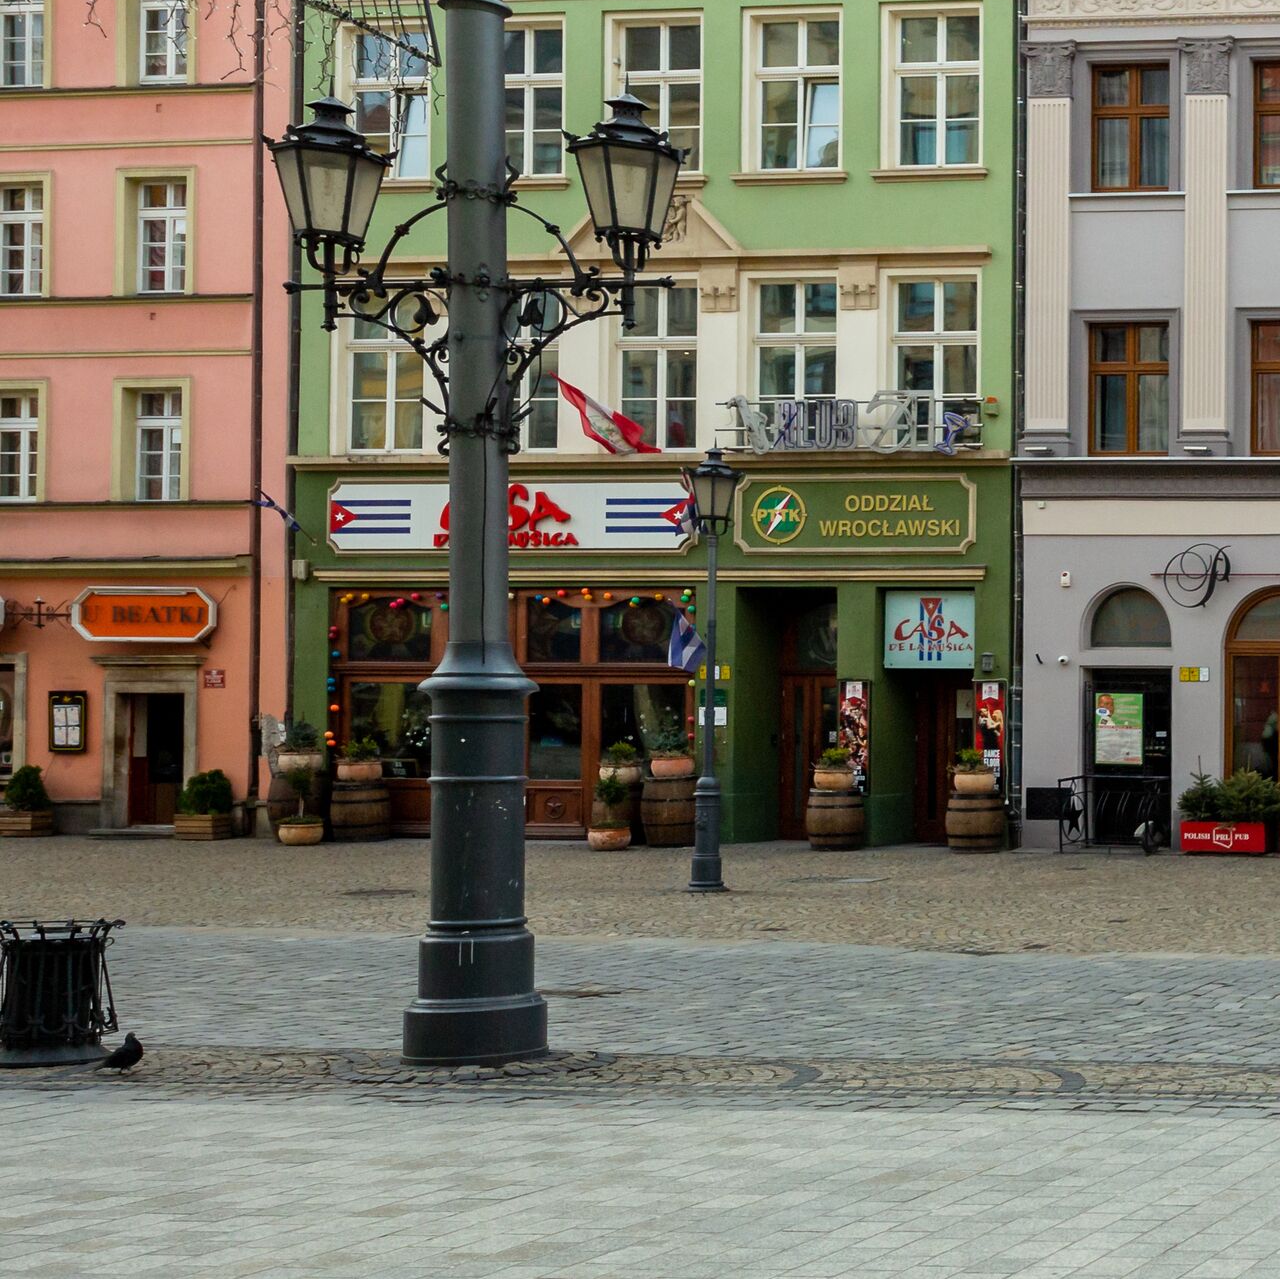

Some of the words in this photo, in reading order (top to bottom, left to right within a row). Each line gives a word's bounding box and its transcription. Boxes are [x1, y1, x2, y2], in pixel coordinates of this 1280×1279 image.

[844, 494, 935, 513] ODDZIAŁ
[757, 508, 801, 522] PTTK
[819, 518, 961, 538] WROCŁAWSKI
[111, 606, 206, 625] BEATKI
[893, 614, 969, 643] CASA
[889, 642, 905, 651] DE
[909, 642, 925, 651] LA
[1183, 832, 1211, 840] POLISH
[1234, 833, 1250, 841] PUB
